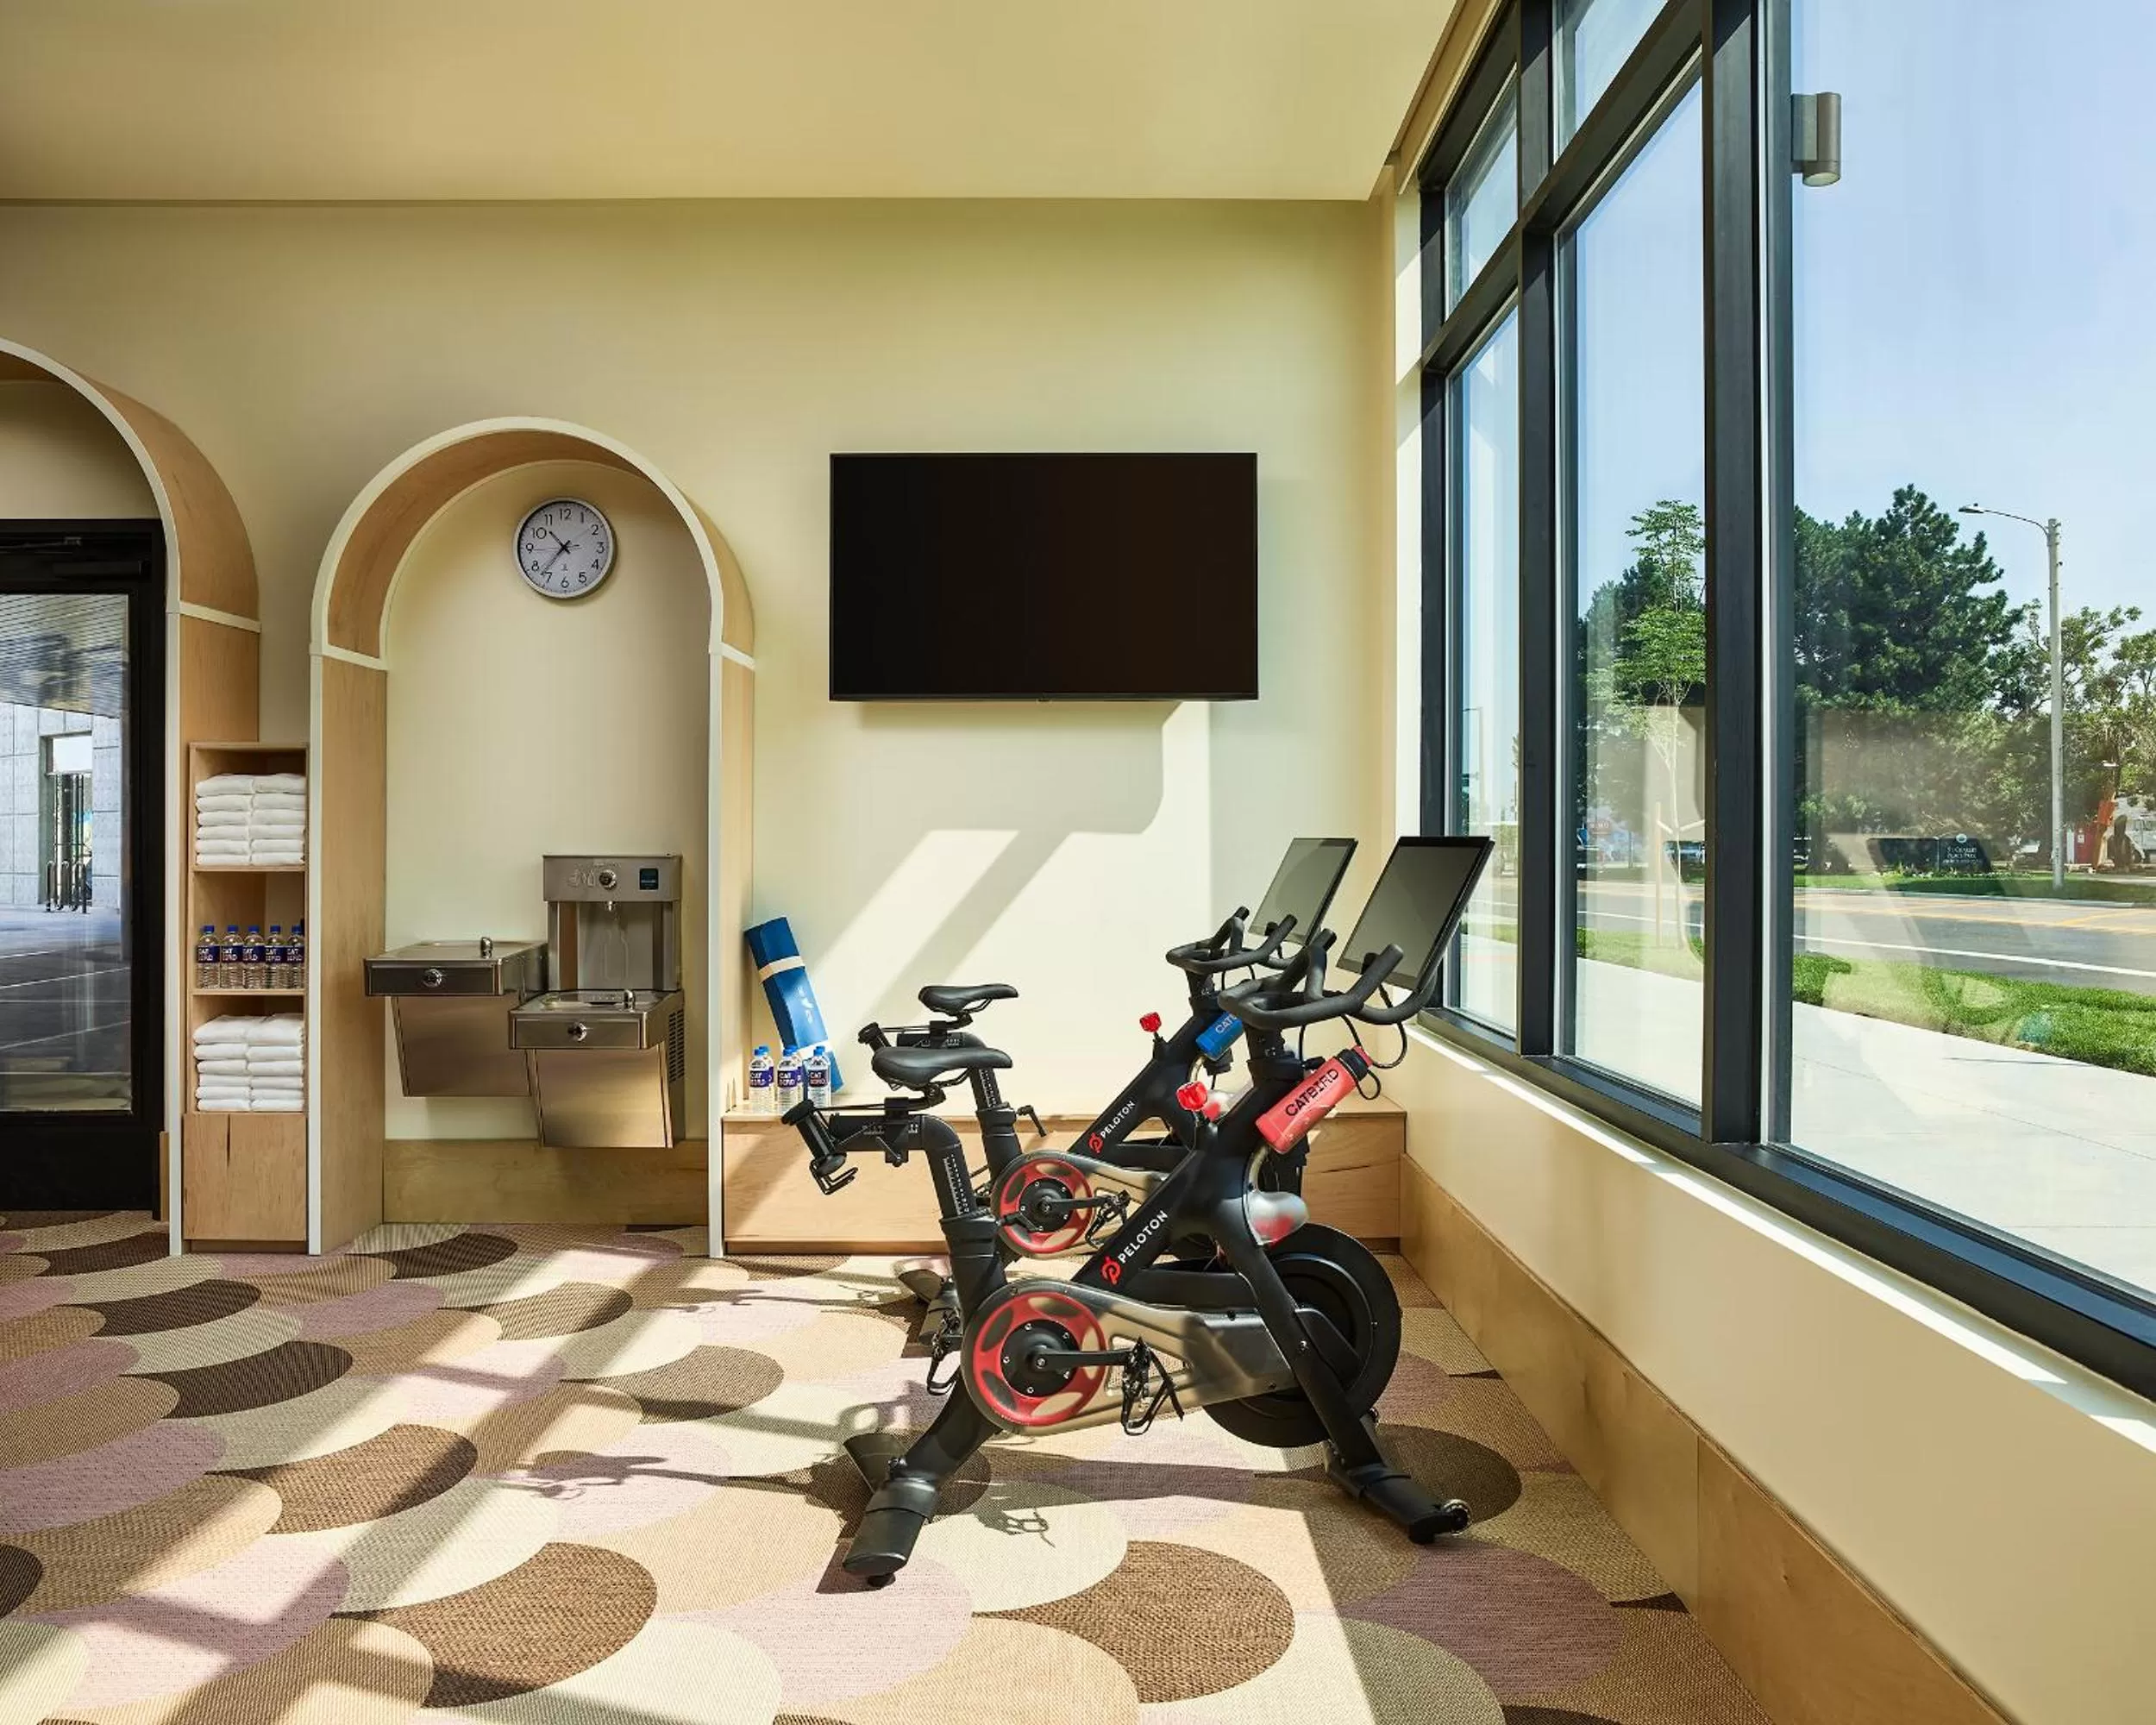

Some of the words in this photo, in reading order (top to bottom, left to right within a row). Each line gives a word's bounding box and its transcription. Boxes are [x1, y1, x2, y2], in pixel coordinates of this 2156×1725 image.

[544, 513, 553, 525] 11
[559, 508, 572, 521] 12
[580, 511, 585, 524] 1
[531, 527, 547, 539] 10
[590, 524, 599, 536] 2
[525, 543, 534, 554] 9
[596, 542, 605, 554] 3
[531, 560, 540, 572] 8
[591, 559, 599, 570] 4
[544, 571, 553, 583] 7
[560, 575, 570, 588] 6
[578, 571, 587, 583] 5
[1285, 1069, 1339, 1116] CATBIRD
[1100, 1100, 1136, 1138] PELOTON
[1117, 1210, 1169, 1264] PELOTON
